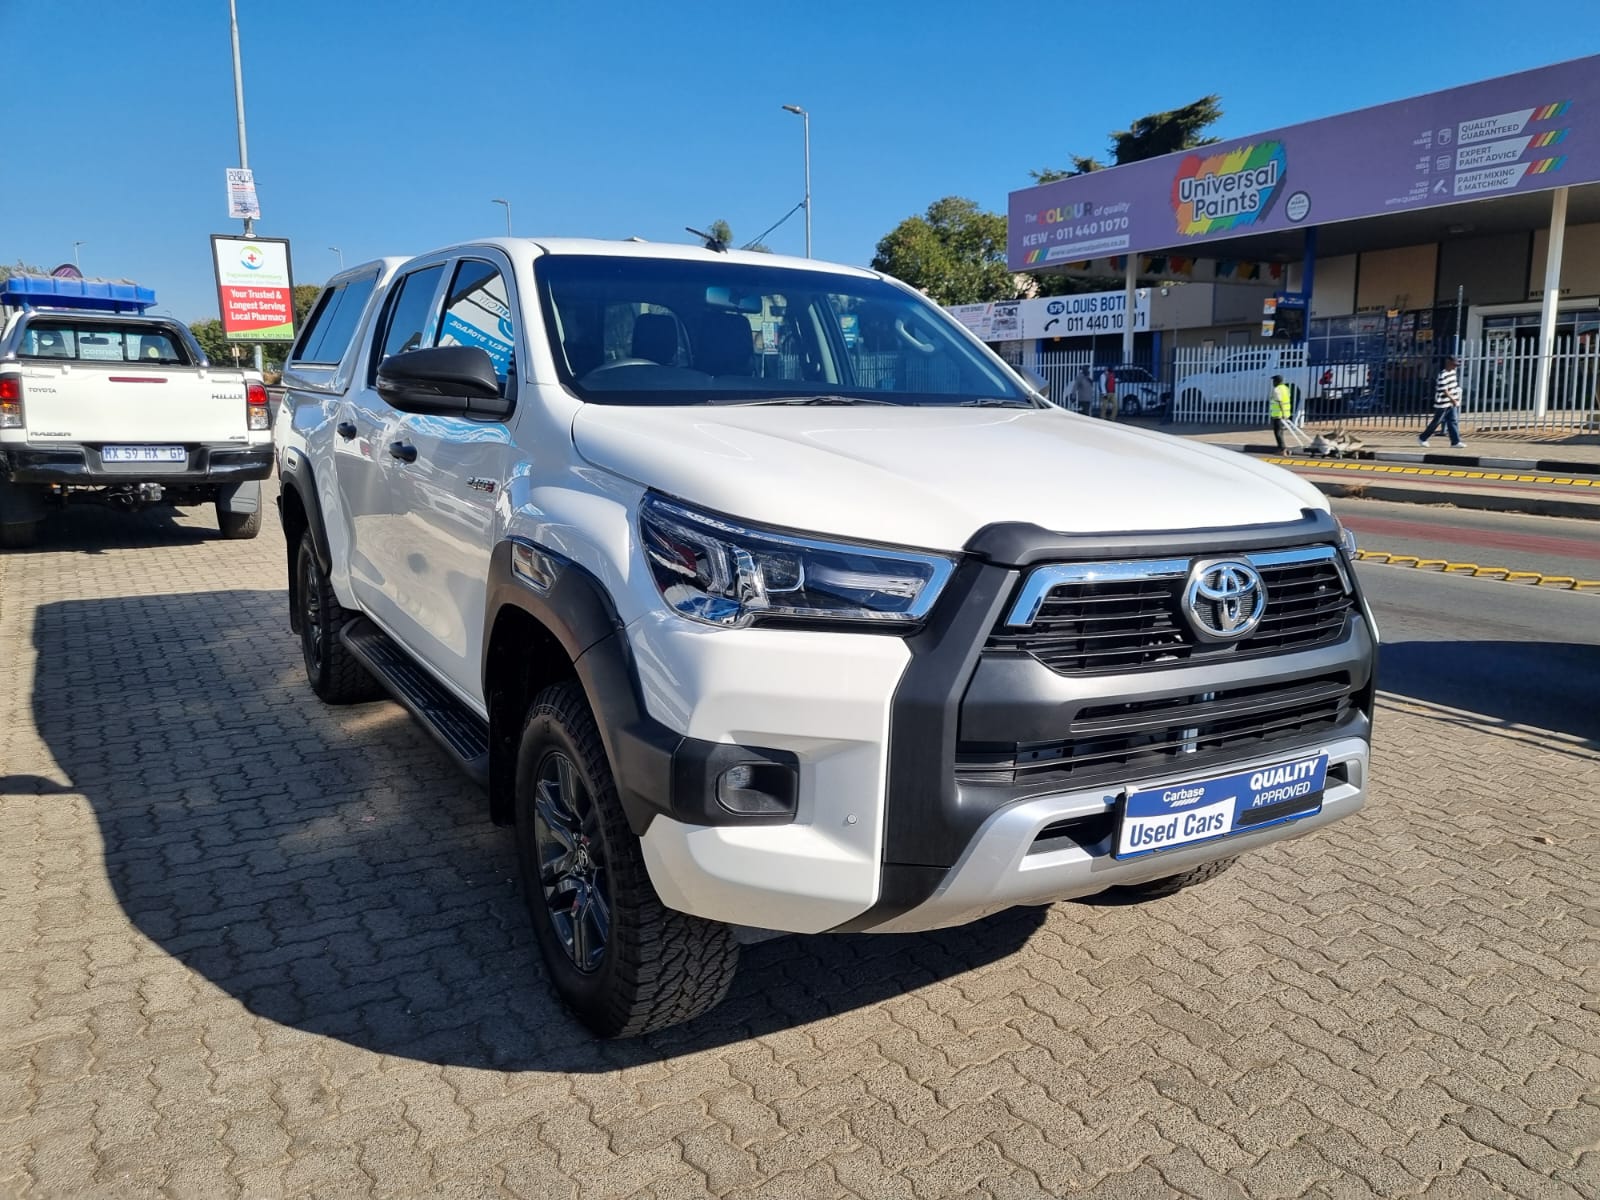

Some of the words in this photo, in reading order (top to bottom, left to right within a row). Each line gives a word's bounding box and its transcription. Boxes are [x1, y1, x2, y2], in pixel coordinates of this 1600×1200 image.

[1461, 119, 1498, 133] QUALITY
[1461, 124, 1520, 141] GUARANTEED
[1459, 156, 1484, 167] PAINT
[1485, 150, 1518, 162] ADVICE
[1460, 146, 1492, 159] EXPERT
[1181, 162, 1276, 201] Universal
[1457, 173, 1482, 185] PAINT
[1484, 168, 1515, 179] MIXING
[1463, 178, 1509, 191] MATCHING
[1194, 191, 1258, 219] Paints
[1025, 213, 1036, 224] The
[1037, 202, 1093, 226] COLOUR
[1094, 206, 1103, 217] of
[1103, 202, 1131, 217] quality
[1023, 231, 1048, 247] KEW
[1056, 226, 1073, 241] 011
[1075, 221, 1098, 236] 440
[1100, 216, 1129, 233] 1070
[230, 288, 247, 298] Your
[248, 289, 275, 299] Trusted
[276, 290, 282, 299] &
[229, 300, 258, 311] Longest
[259, 301, 286, 312] Serving
[1066, 298, 1097, 315] LOUIS
[231, 312, 250, 321] Local
[251, 312, 287, 323] Pharmacy
[1067, 317, 1083, 332] 011
[1086, 315, 1109, 330] 440
[124, 447, 138, 459] 59
[169, 447, 184, 459] GP
[1250, 758, 1319, 791] QUALITY
[1163, 786, 1205, 803] Carbase
[1252, 781, 1311, 808] APPROVED
[1130, 819, 1177, 848] Used
[1183, 812, 1225, 837] Cars
